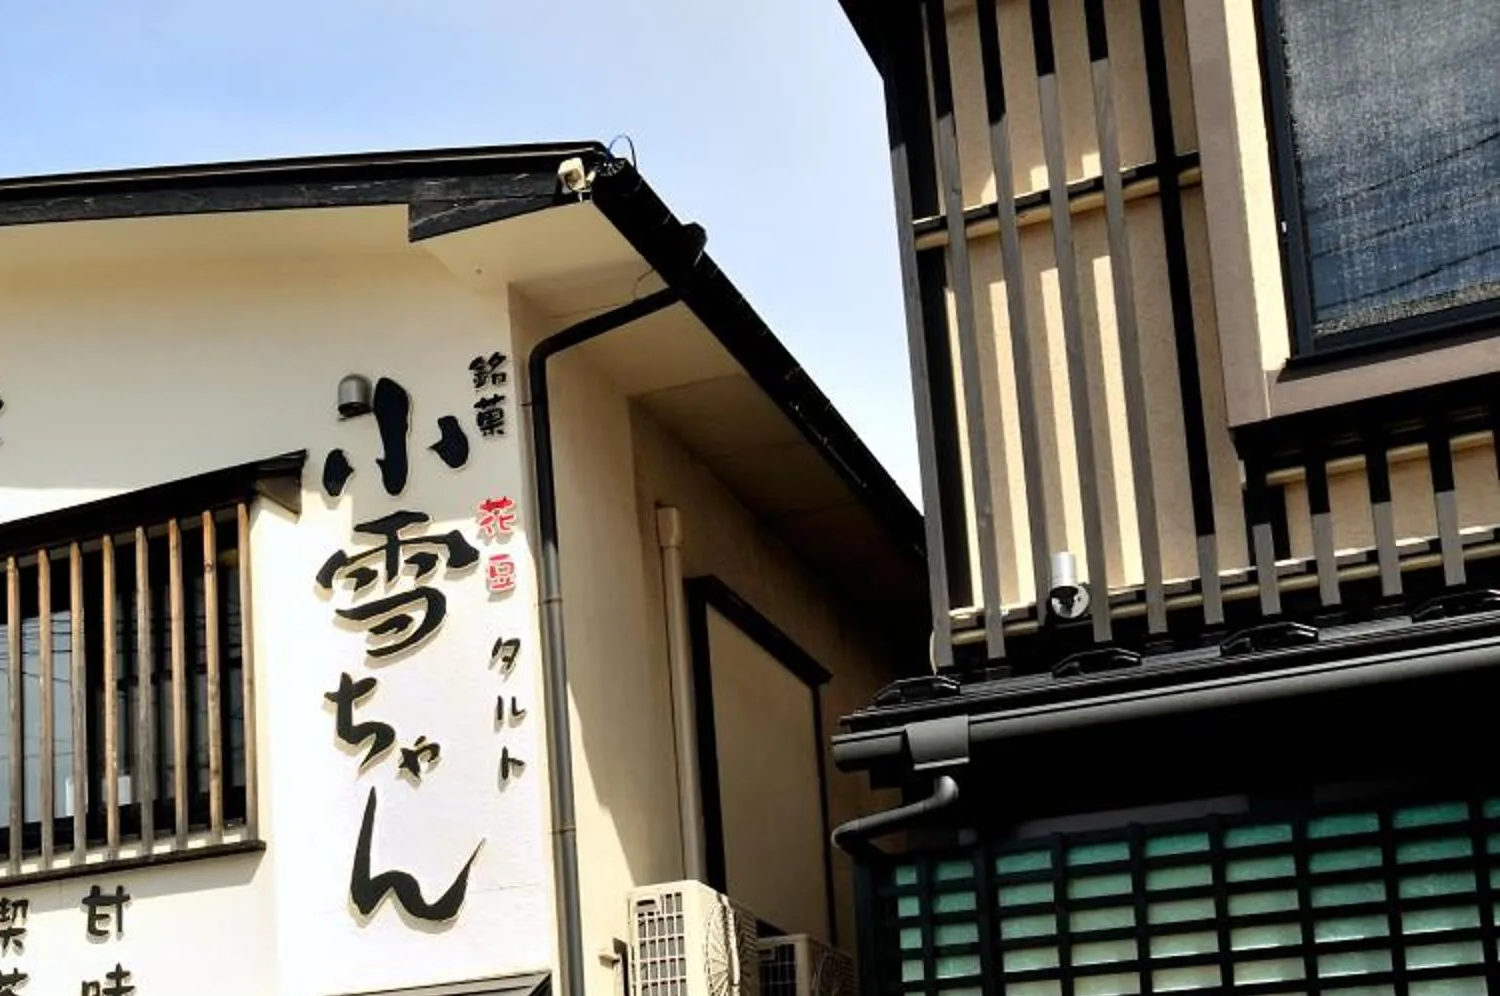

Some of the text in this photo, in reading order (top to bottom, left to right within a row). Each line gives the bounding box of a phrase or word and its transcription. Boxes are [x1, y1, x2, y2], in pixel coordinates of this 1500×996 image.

[316, 376, 485, 922] 小雪ちゃん
[469, 352, 527, 779] 銘菓 花豆 タルト
